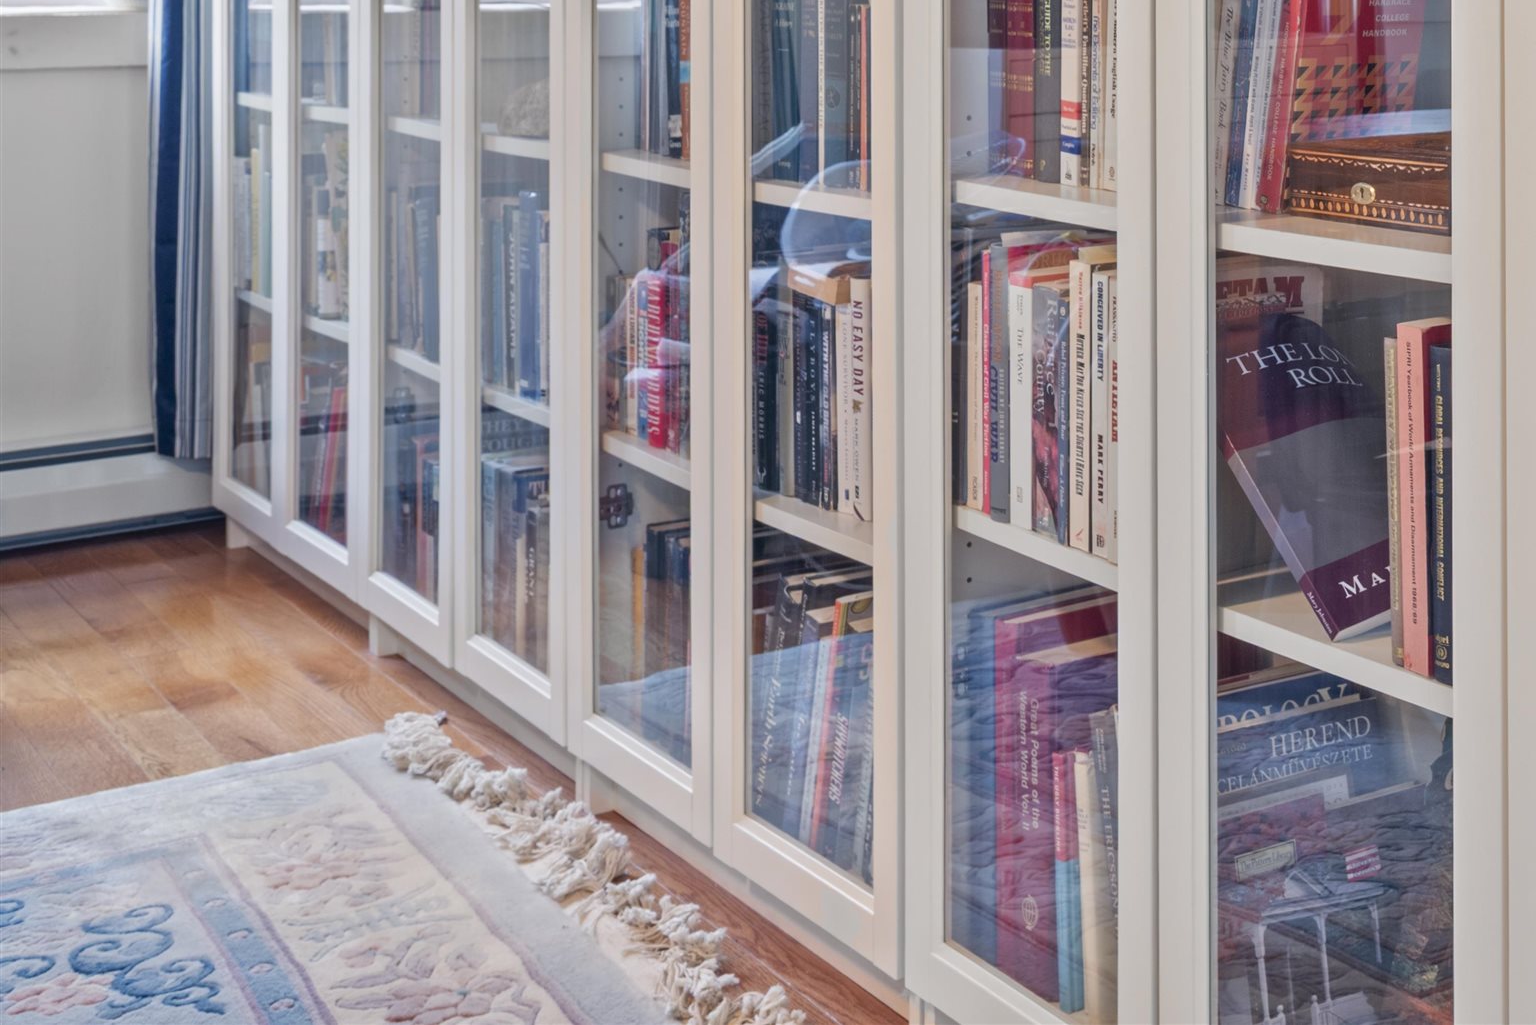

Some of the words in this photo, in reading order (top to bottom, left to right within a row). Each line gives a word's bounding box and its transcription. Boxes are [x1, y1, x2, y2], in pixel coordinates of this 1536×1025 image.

[1362, 28, 1408, 38] HANDBOOK
[1375, 12, 1411, 22] COLLEGE
[853, 300, 864, 320] NO
[1096, 280, 1104, 331] CONCEIVED
[852, 325, 864, 362] EASY
[1226, 343, 1303, 376] THE
[852, 367, 864, 396] DAY
[1016, 353, 1024, 385] WAVE
[1096, 344, 1104, 382] LIBERTY
[1287, 366, 1364, 389] ROLL
[1033, 350, 1046, 415] County
[1435, 496, 1445, 558] INTERNATIONAL
[1435, 561, 1446, 601] CONFLICT
[1269, 715, 1371, 759] HEREND
[828, 712, 851, 805] SKYWATCHERS
